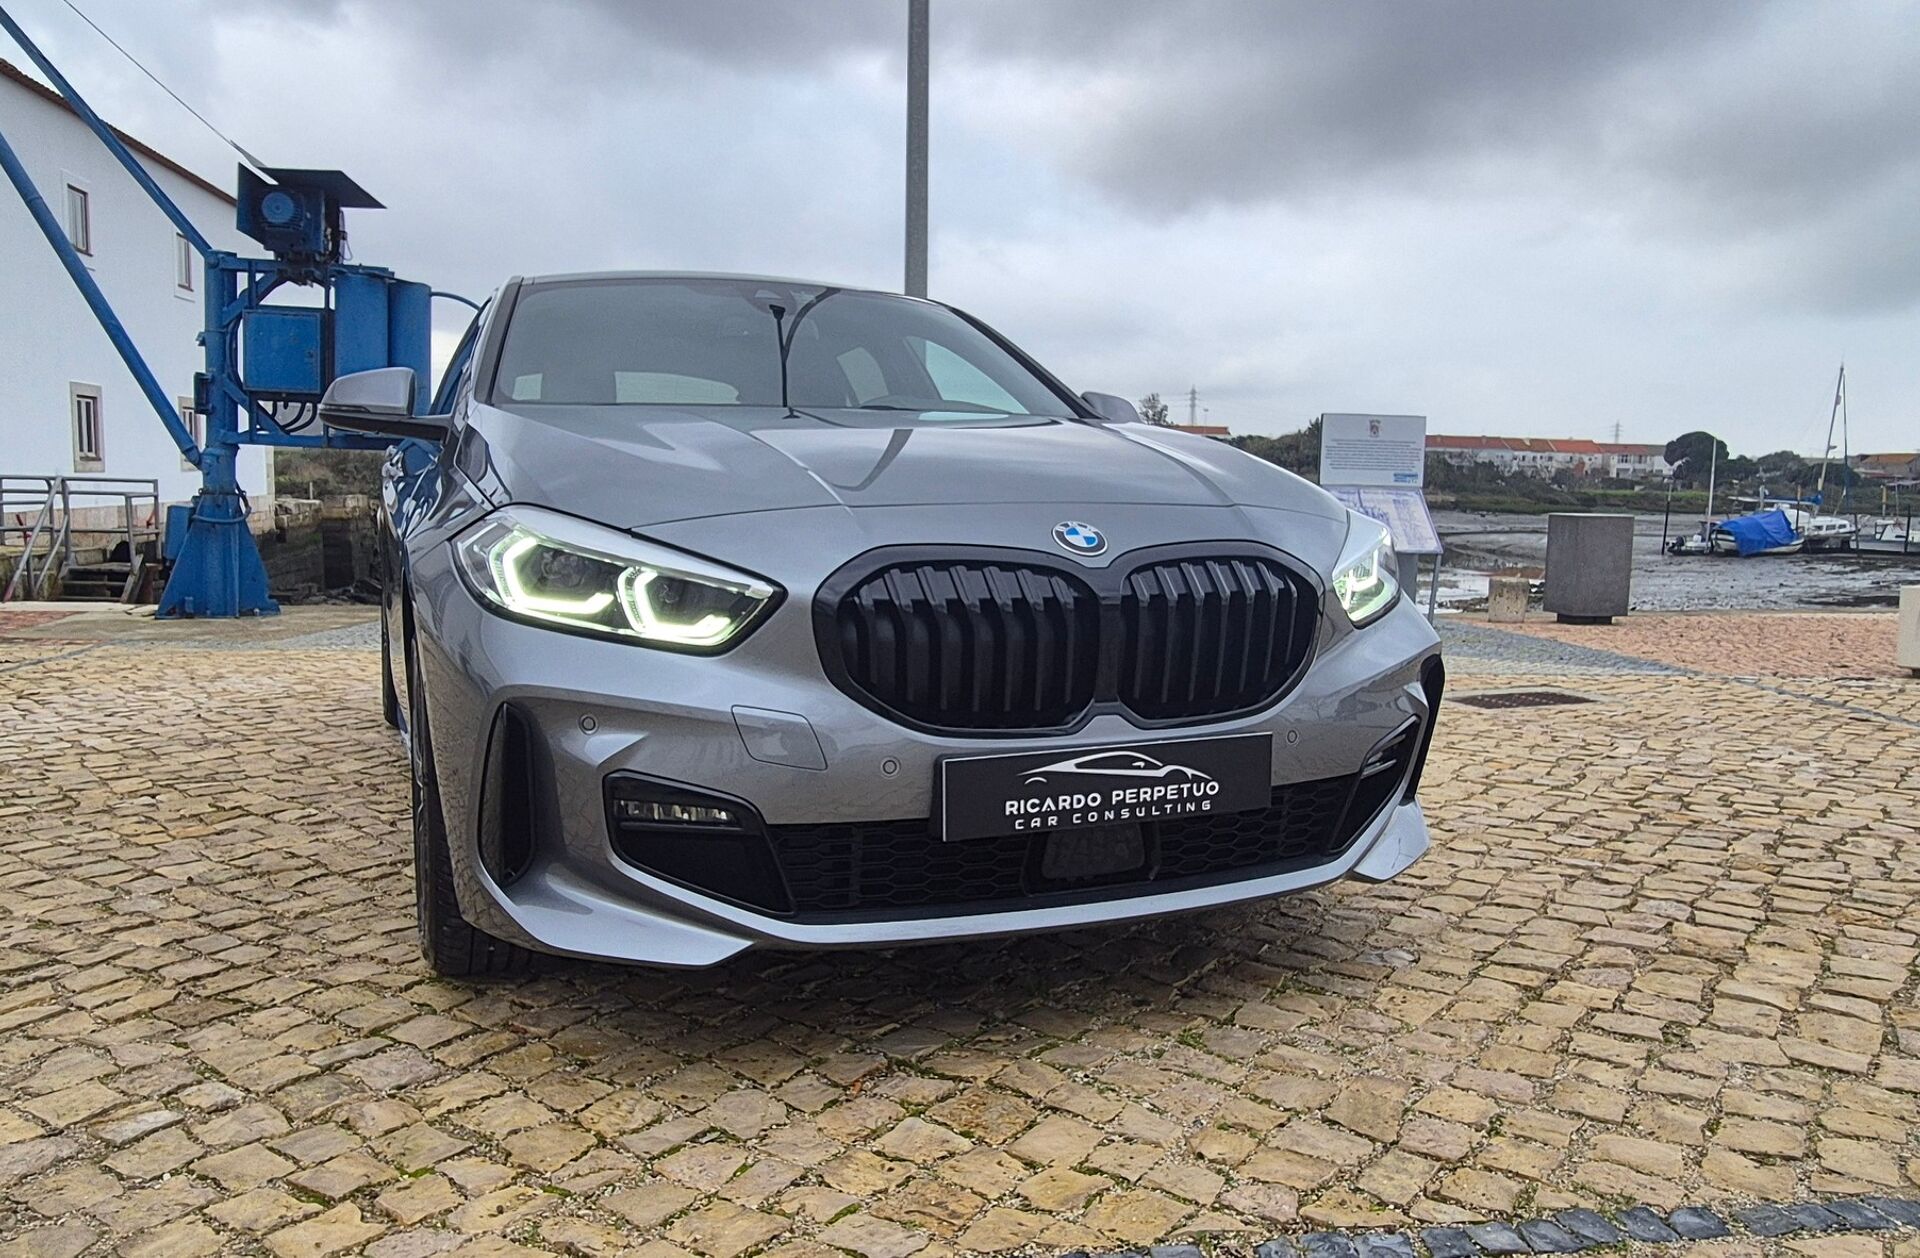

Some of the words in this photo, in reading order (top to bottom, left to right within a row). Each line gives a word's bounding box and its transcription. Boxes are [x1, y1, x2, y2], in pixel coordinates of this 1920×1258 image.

[1005, 792, 1102, 816] RICARDO
[1112, 781, 1220, 806] PERPETUO
[1015, 816, 1058, 830] CAR
[1072, 800, 1212, 824] CONSULTING
